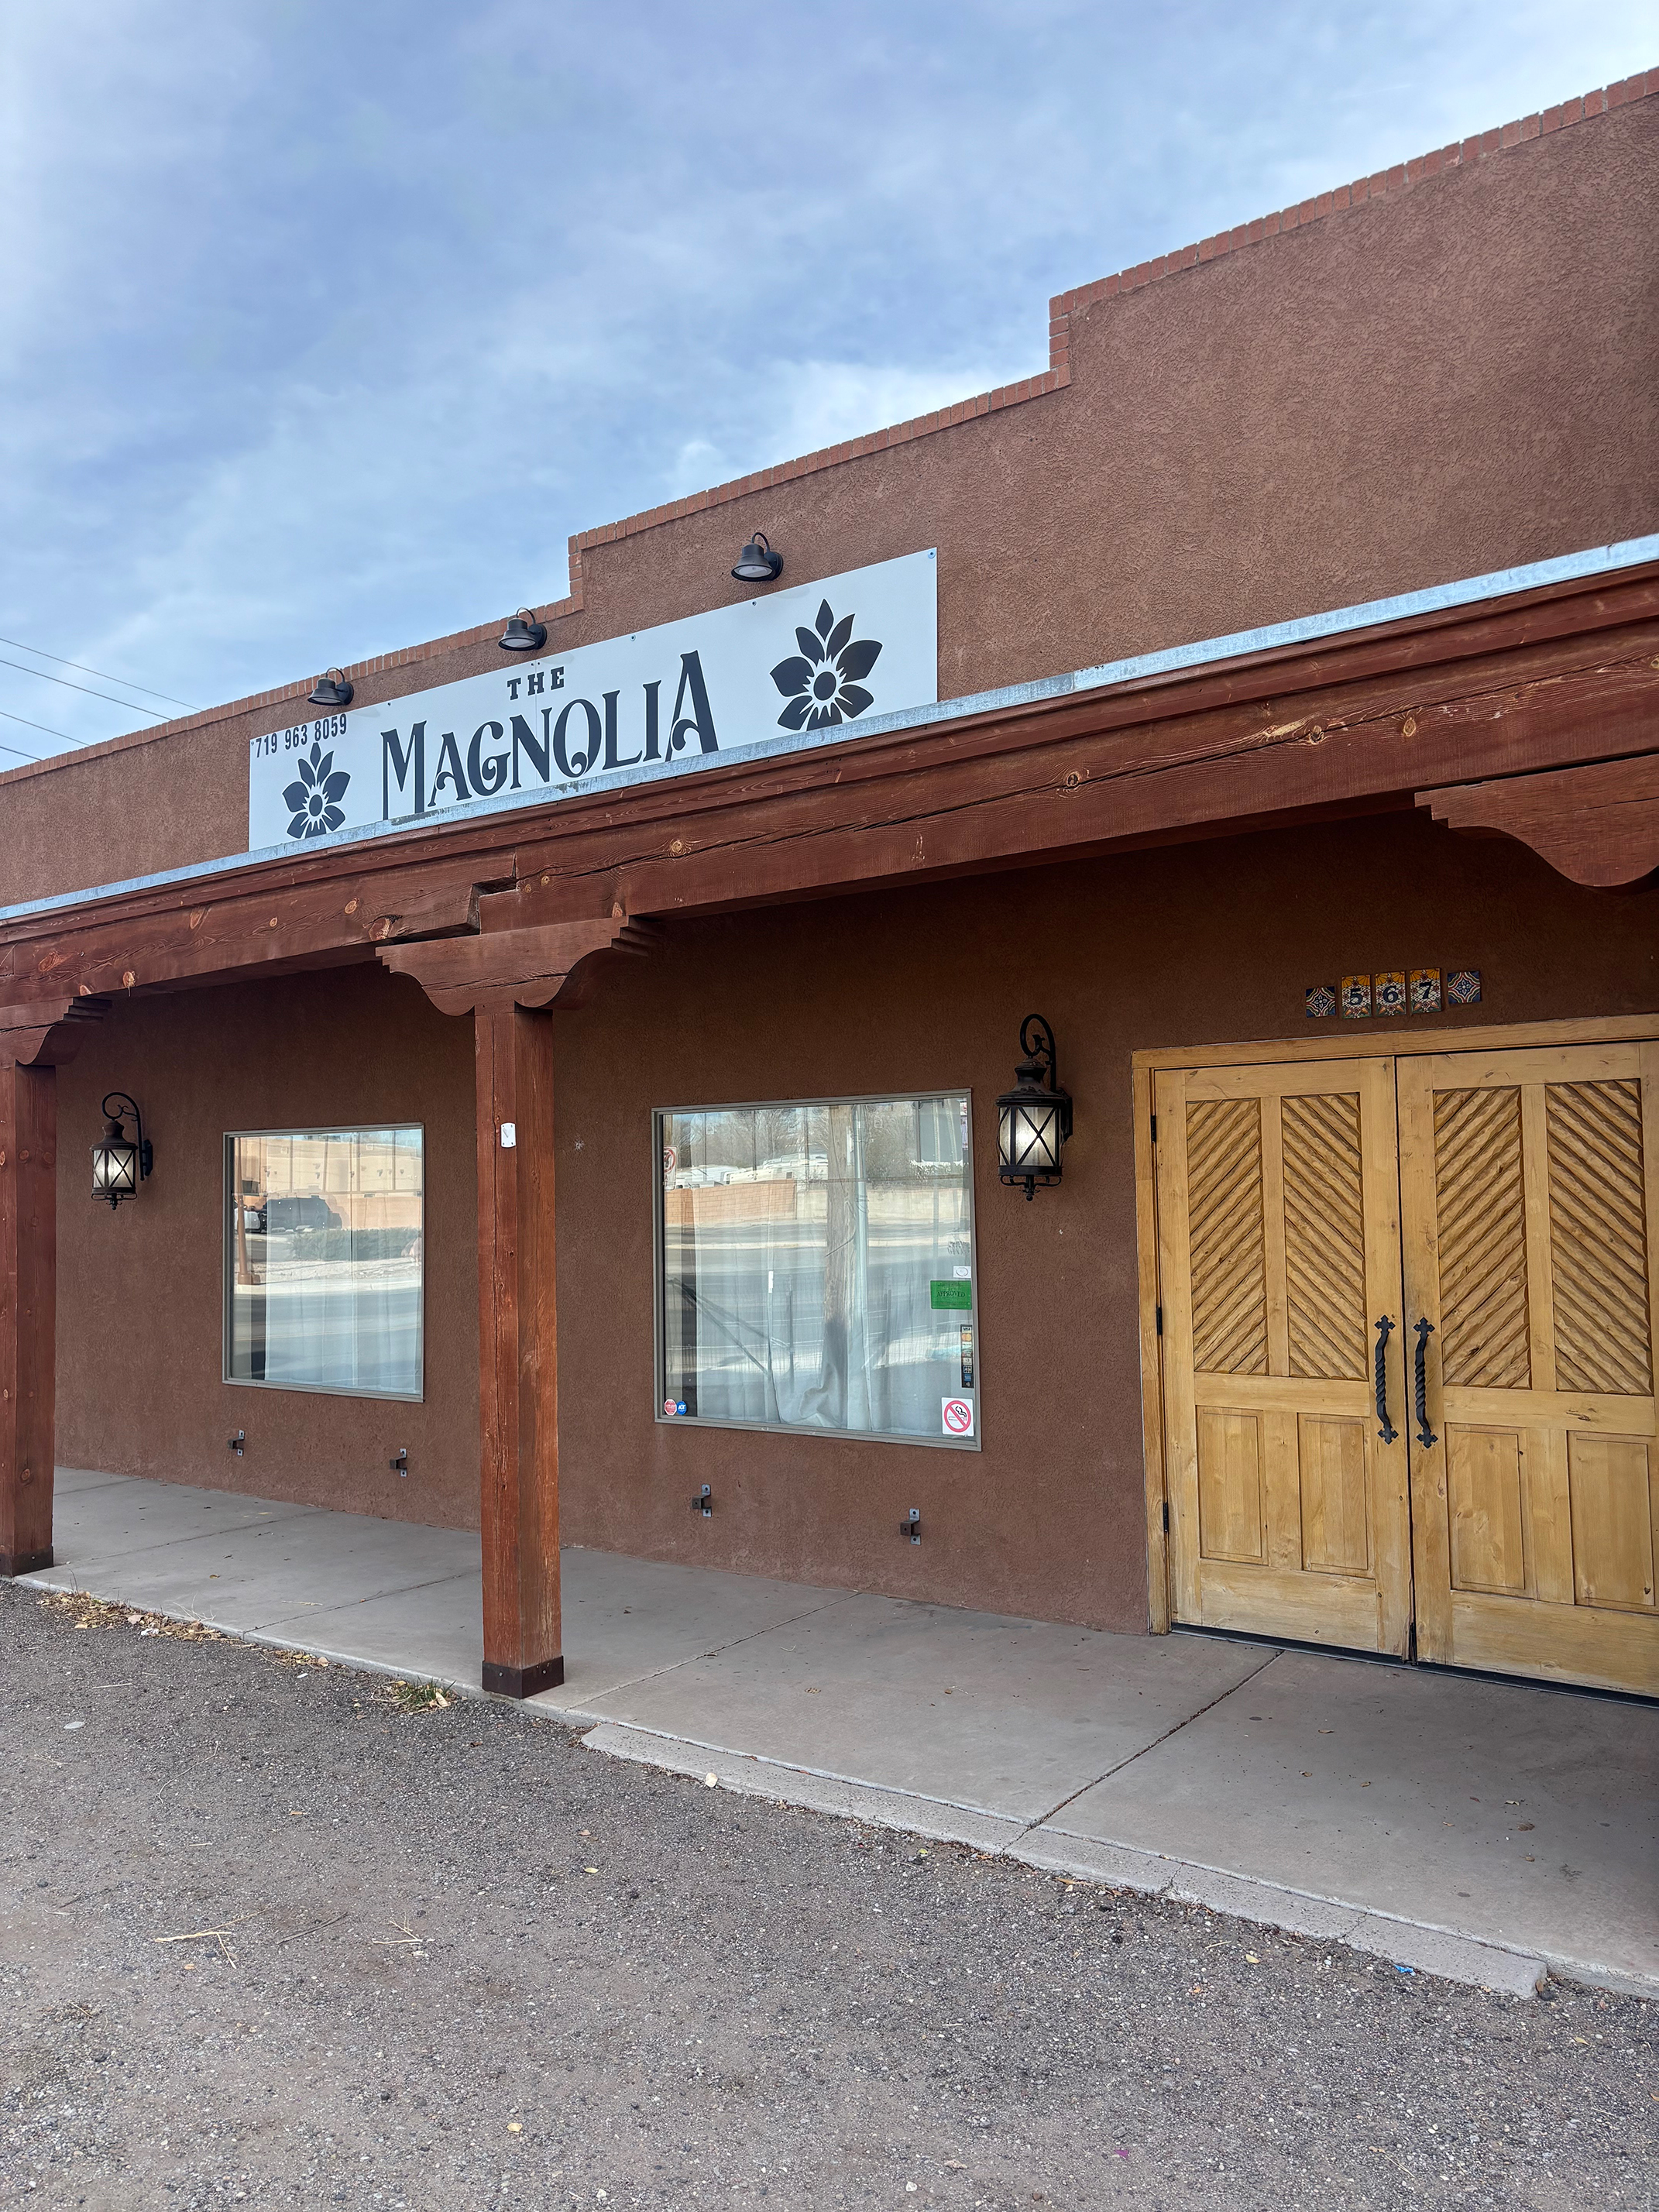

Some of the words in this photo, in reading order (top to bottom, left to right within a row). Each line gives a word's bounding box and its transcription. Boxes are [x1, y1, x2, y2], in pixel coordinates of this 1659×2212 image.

[507, 666, 565, 700] THE
[256, 733, 277, 758] 719
[285, 724, 307, 750] 963
[314, 713, 347, 741] 8059
[380, 650, 720, 820] MAGNOLIA
